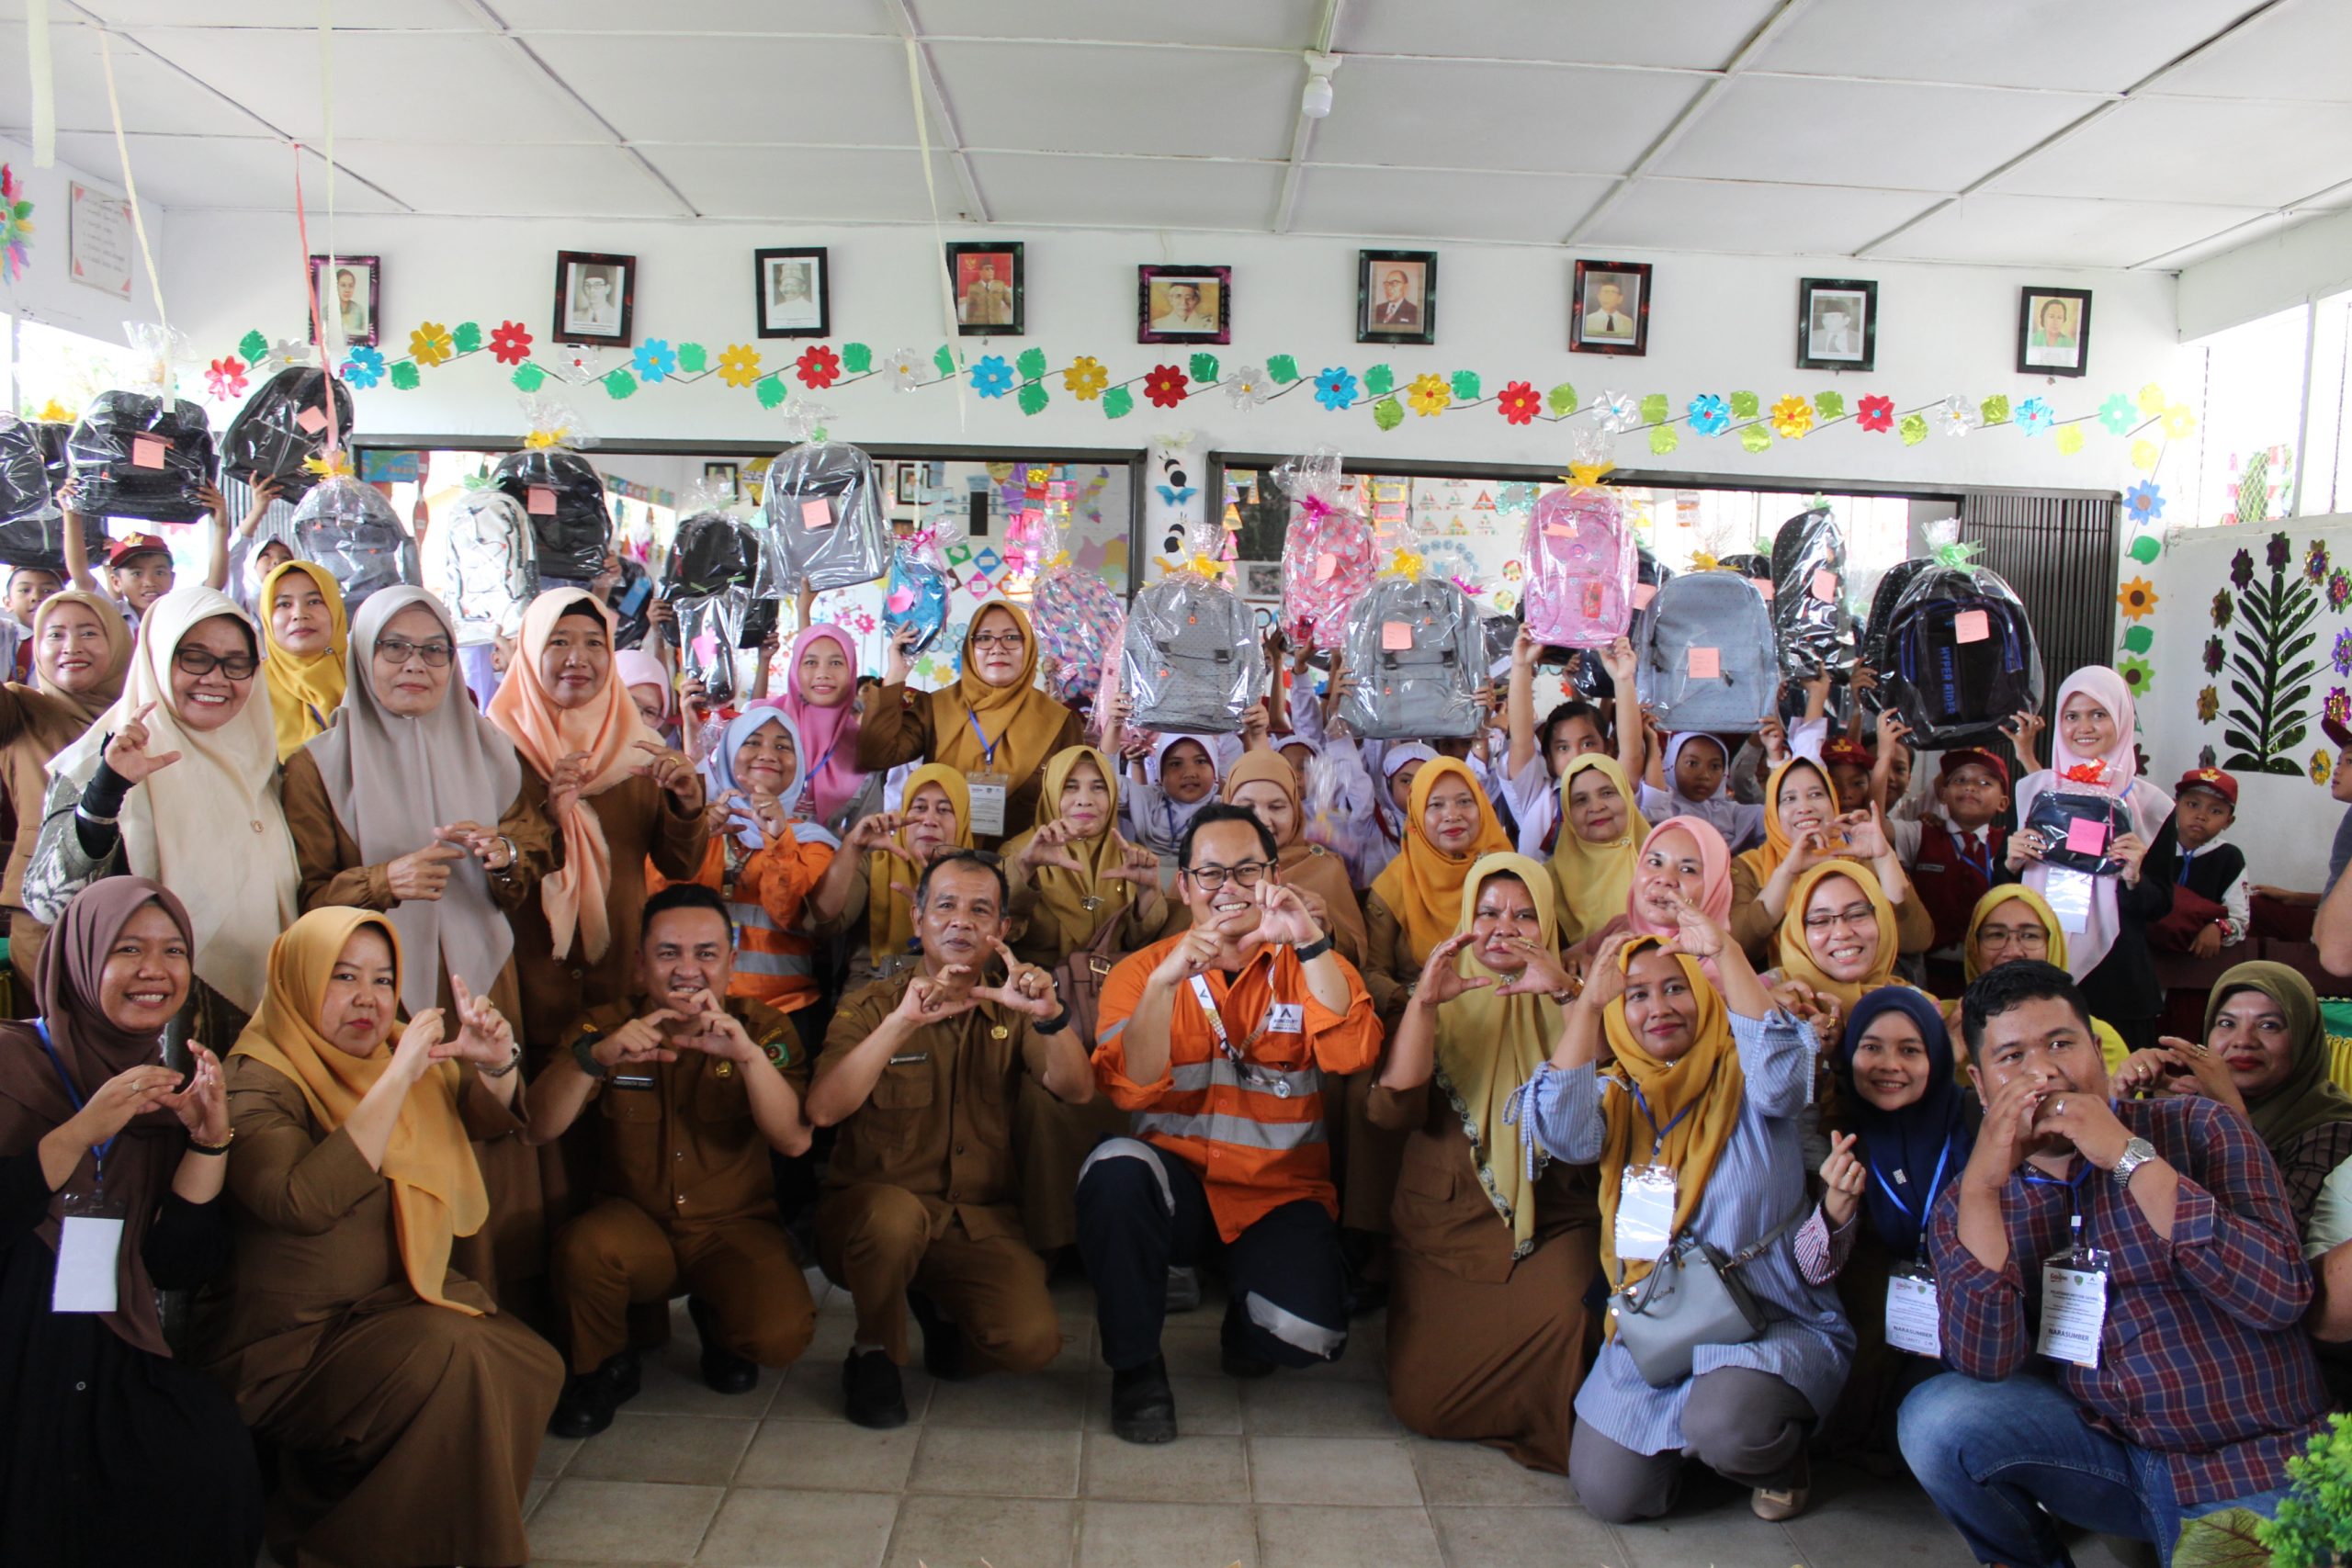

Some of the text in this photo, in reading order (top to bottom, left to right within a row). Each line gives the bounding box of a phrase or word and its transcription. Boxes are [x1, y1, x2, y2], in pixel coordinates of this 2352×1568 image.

[1939, 647, 1956, 714] HYPER RIDER
[1894, 1325, 1933, 1338] NARASUMBER
[2048, 1327, 2089, 1341] NARASUMBER
